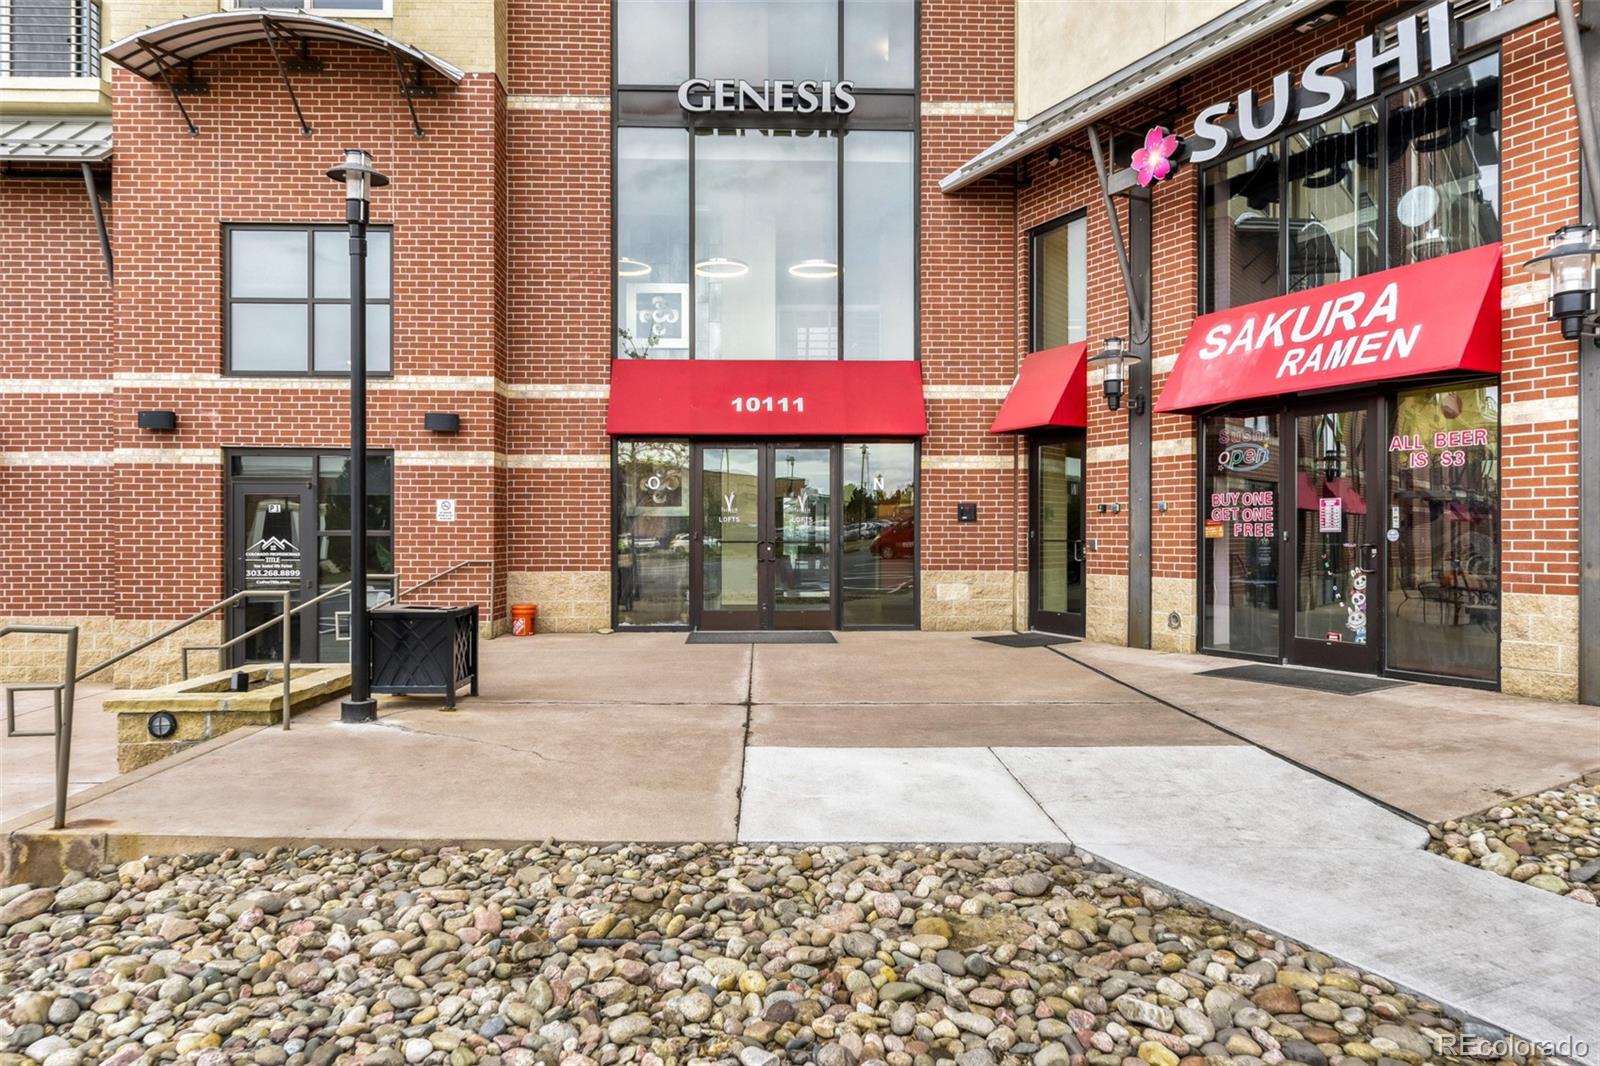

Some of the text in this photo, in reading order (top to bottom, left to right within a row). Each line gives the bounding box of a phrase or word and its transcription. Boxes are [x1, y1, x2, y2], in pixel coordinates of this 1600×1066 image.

[1190, 1, 1455, 163] SUSHI
[677, 78, 856, 114] GENESIS
[1199, 282, 1398, 361] SAKURA
[1276, 324, 1422, 379] RAMEN
[731, 397, 804, 413] 10111
[1389, 429, 1488, 451] ALL BEER
[1409, 452, 1428, 468] IS
[1211, 491, 1273, 507] BUY ONE
[792, 516, 813, 524] LOFTS
[1211, 507, 1274, 522] GET ONE
[1233, 523, 1274, 537] FREE
[246, 569, 300, 577] 303.268.8899
